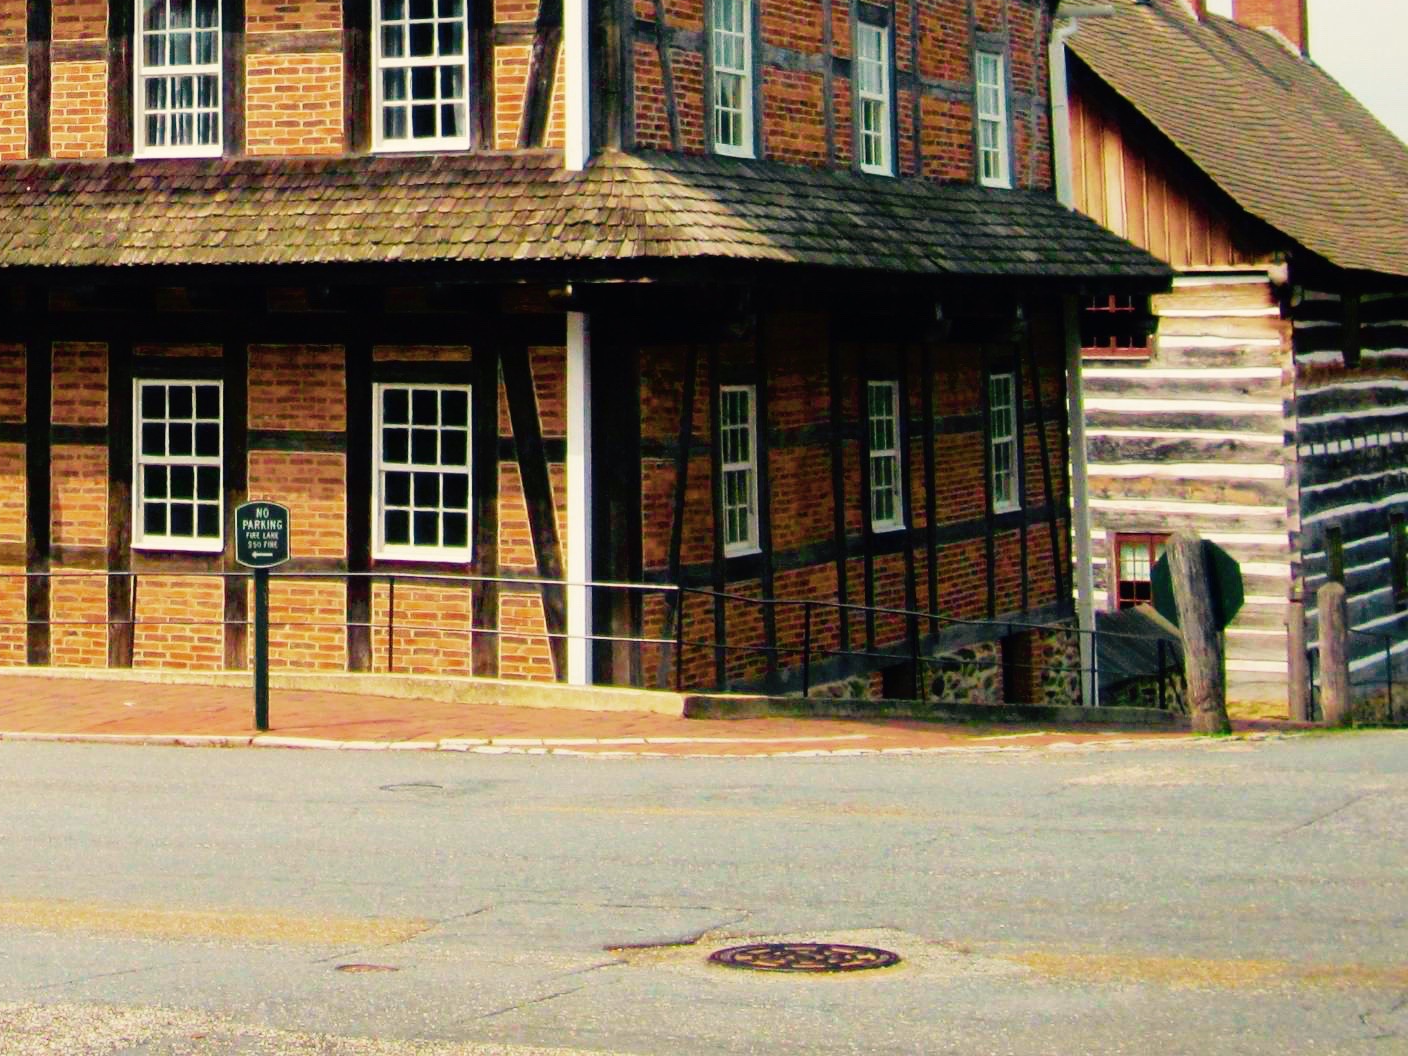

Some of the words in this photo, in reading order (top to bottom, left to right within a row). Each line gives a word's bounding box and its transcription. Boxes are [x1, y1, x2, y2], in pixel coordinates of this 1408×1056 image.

[256, 507, 269, 518] NO
[242, 519, 283, 530] PARKING
[246, 531, 260, 539] FIRE
[263, 531, 279, 539] LANE
[263, 541, 278, 549] FINE
